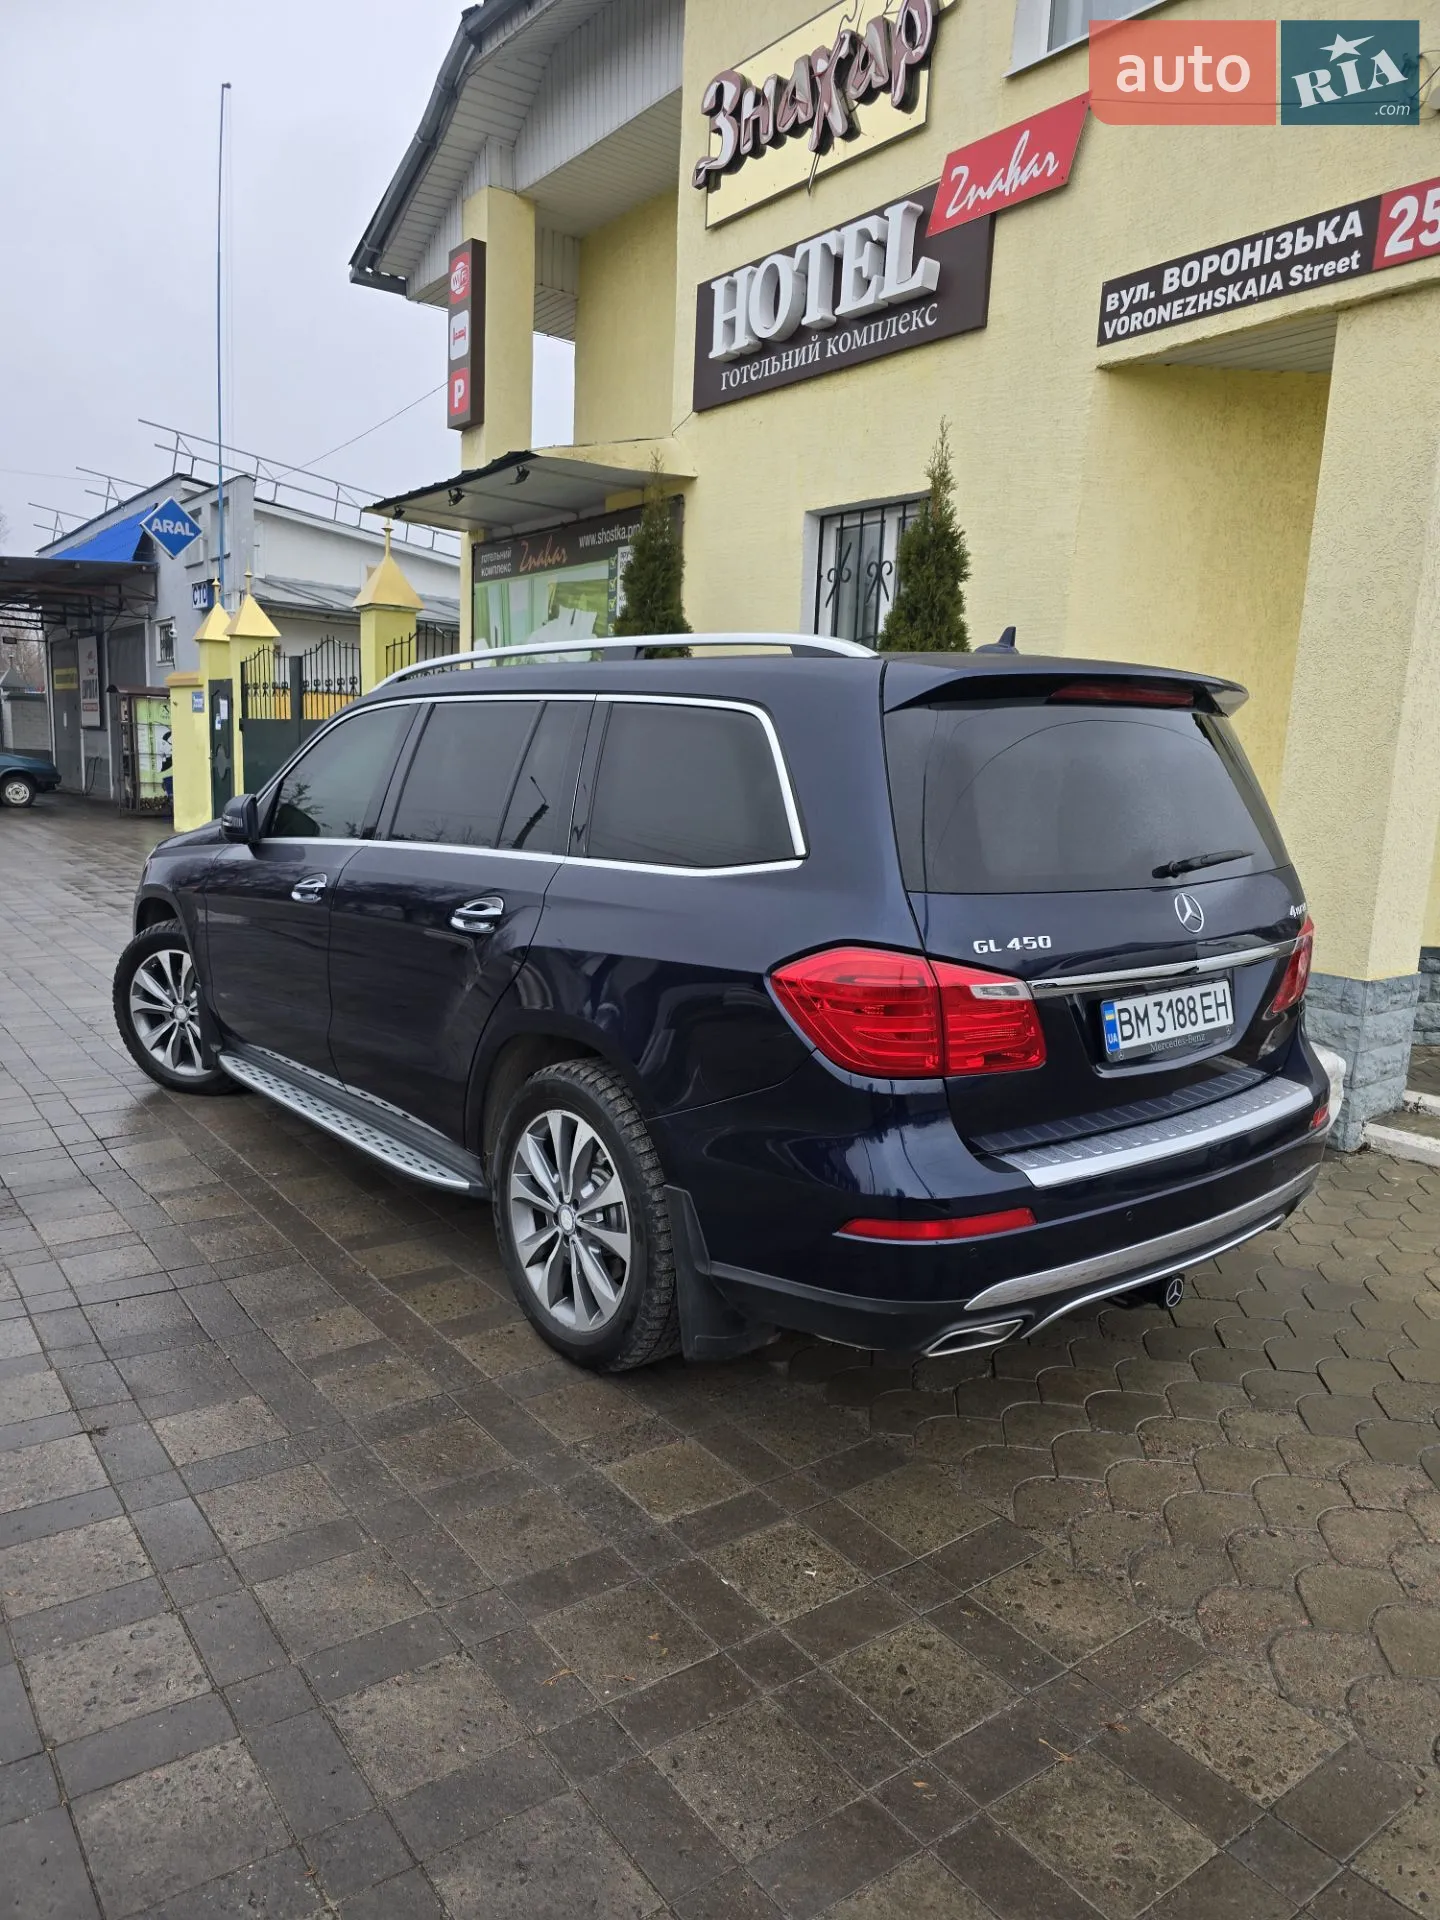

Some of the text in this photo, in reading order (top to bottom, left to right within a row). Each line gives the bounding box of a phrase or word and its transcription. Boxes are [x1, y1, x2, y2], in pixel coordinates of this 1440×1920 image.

[692, 0, 937, 190] Знахар
[709, 200, 940, 362] HOTEL
[1105, 210, 1363, 314] вул. ВОРОНІЗЬКА
[1103, 250, 1361, 339] VORONEZHSKAIA Street
[720, 302, 938, 391] готельний комплекс
[453, 378, 465, 408] P
[151, 518, 195, 537] ARAL
[973, 935, 1052, 954] GL 450
[1107, 1033, 1119, 1045] UA
[1150, 1033, 1206, 1053] Mercedes-Benz
